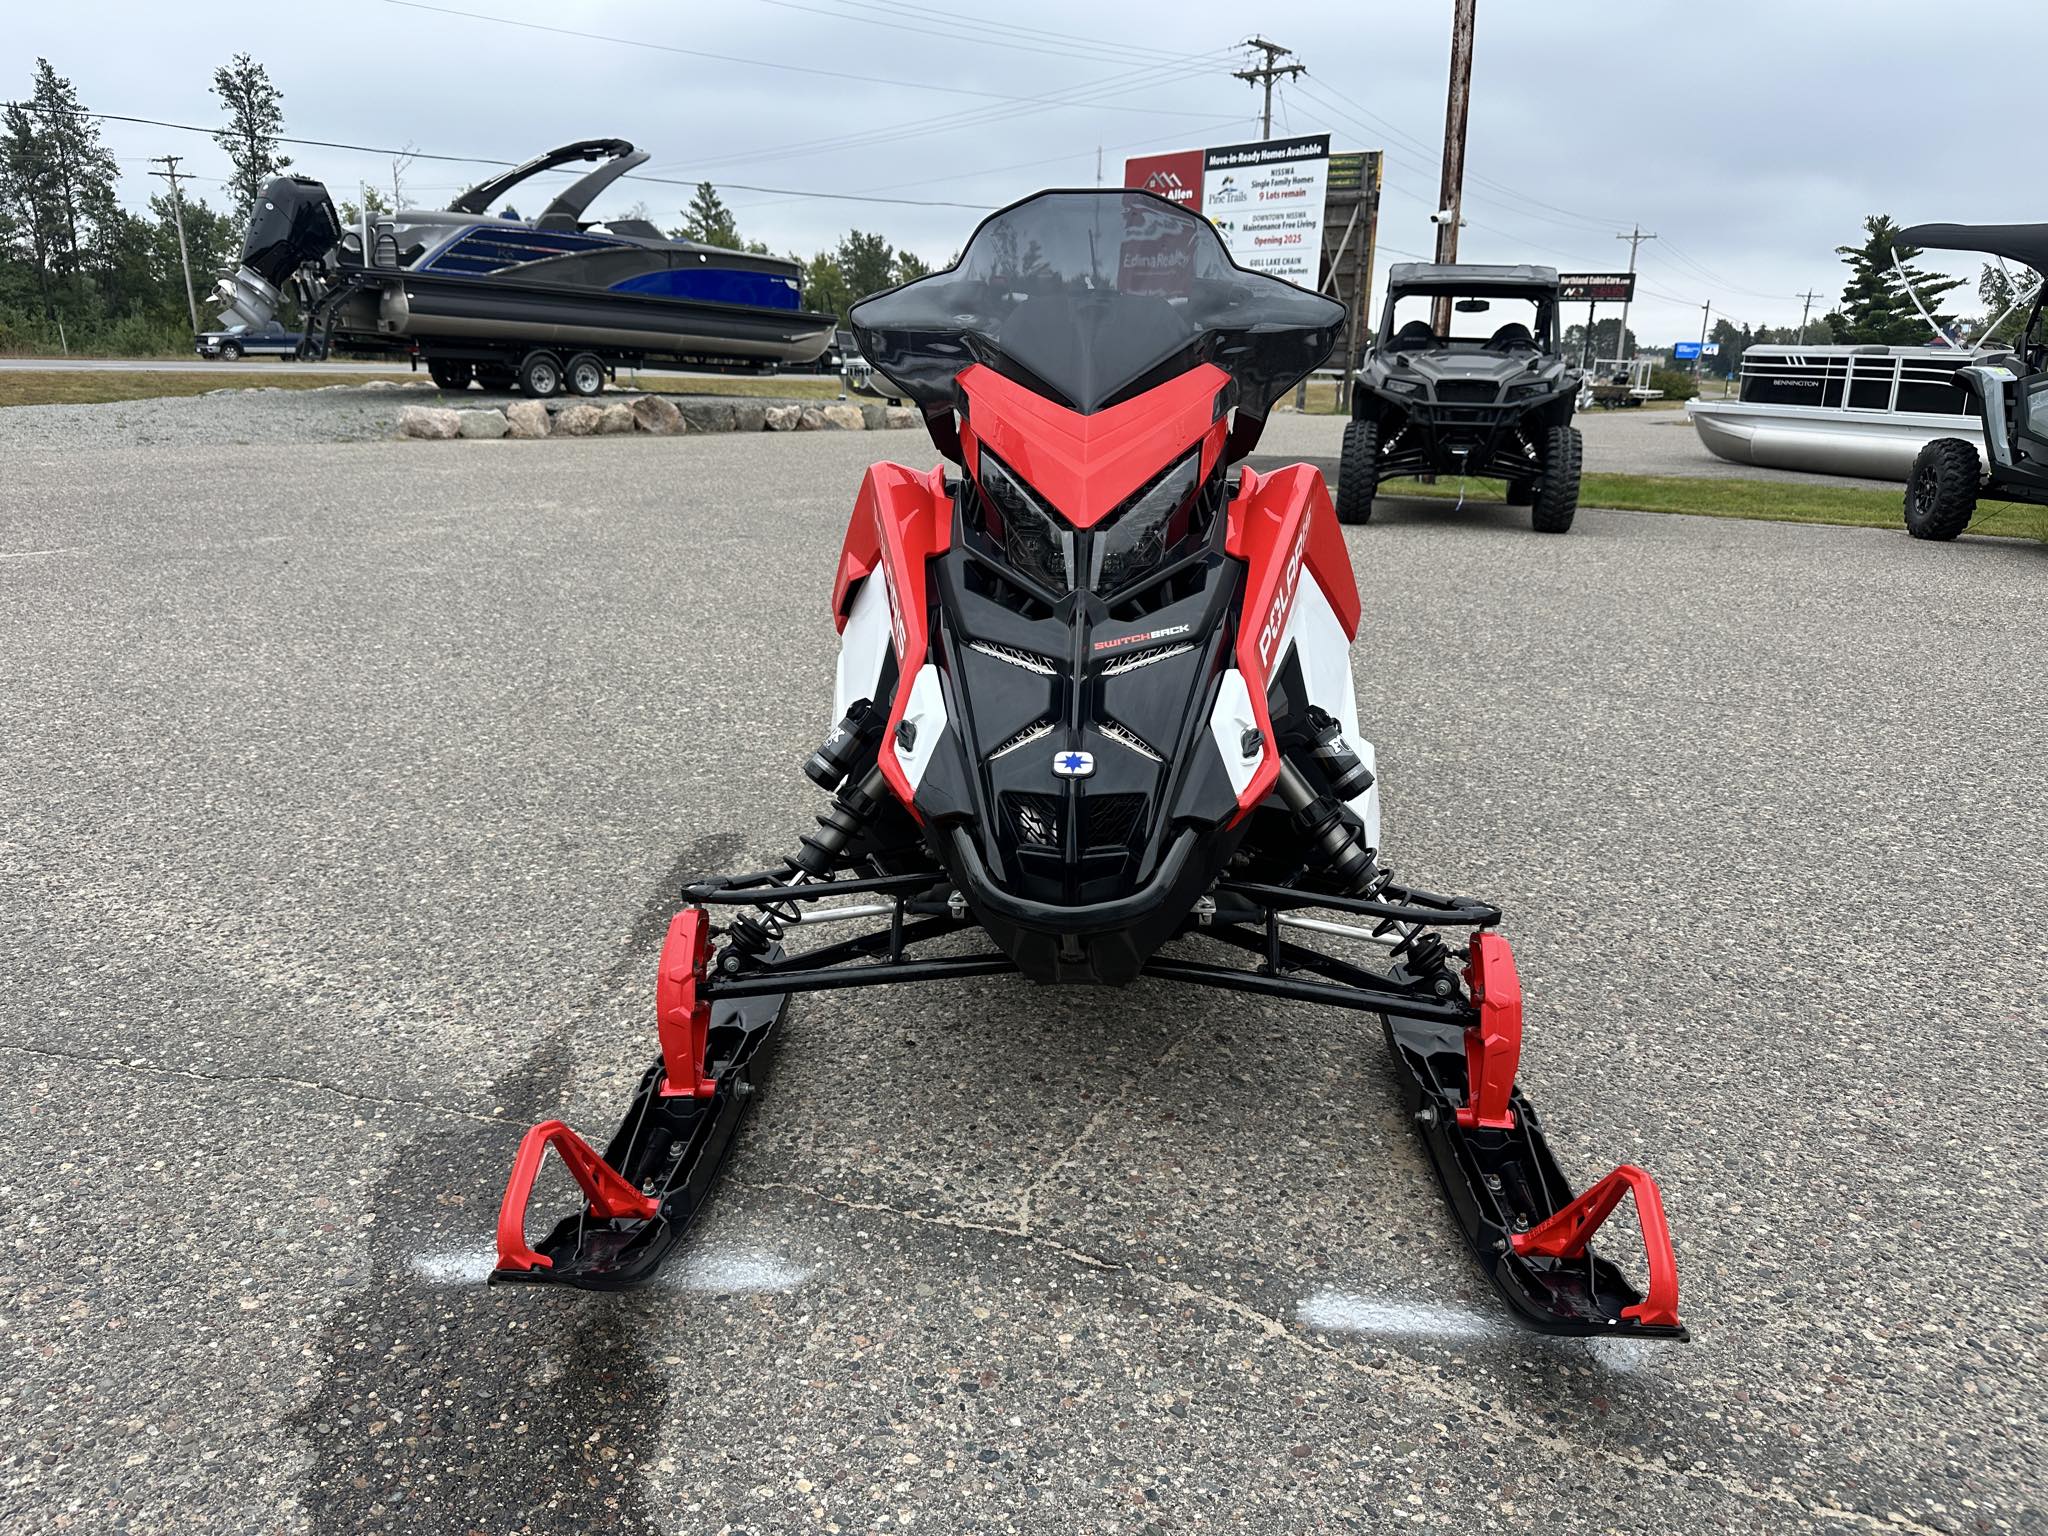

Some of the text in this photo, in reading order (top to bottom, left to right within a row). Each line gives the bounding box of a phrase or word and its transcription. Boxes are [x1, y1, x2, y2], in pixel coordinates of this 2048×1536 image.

[1209, 143, 1322, 165] Move-in-Ready Homes Available
[1270, 167, 1295, 176] NISSWA
[1251, 176, 1314, 189] Single Family Homes
[1167, 188, 1193, 200] Allen
[1208, 191, 1247, 205] Pine Trails
[1266, 191, 1281, 200] Lots
[1281, 189, 1307, 198] remain
[1242, 220, 1317, 231] Maintenance Free Living
[1254, 234, 1302, 246] Opening 2025
[1266, 258, 1280, 266] LAKE
[1282, 257, 1302, 265] CHAIN
[1288, 267, 1308, 275] Homes
[1094, 624, 1190, 650] SWITCHBACK
